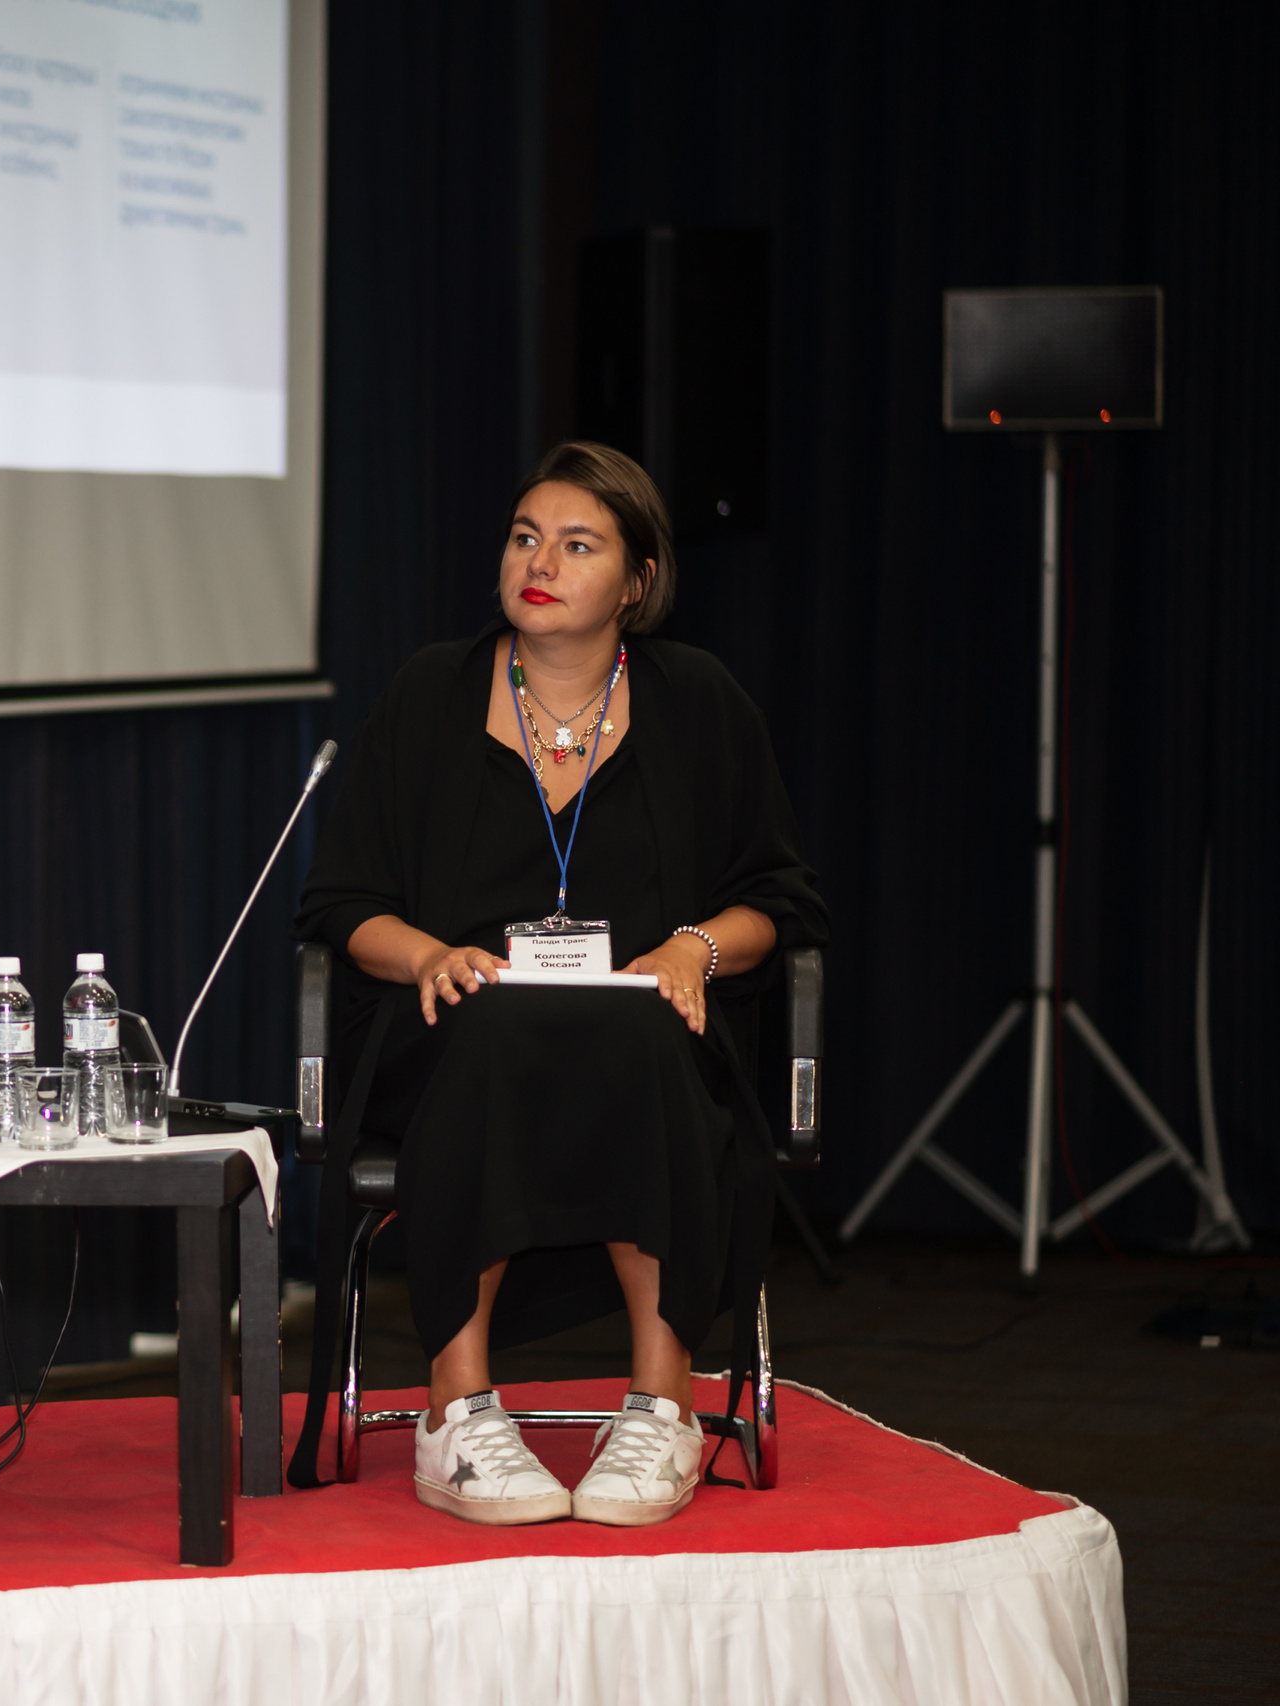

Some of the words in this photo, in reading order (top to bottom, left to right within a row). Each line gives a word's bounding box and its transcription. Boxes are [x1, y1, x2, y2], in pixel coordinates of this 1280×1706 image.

[562, 937, 588, 945] Транс
[534, 952, 587, 960] Колегова
[470, 1395, 491, 1410] GGDB
[630, 1395, 653, 1409] GGDB
